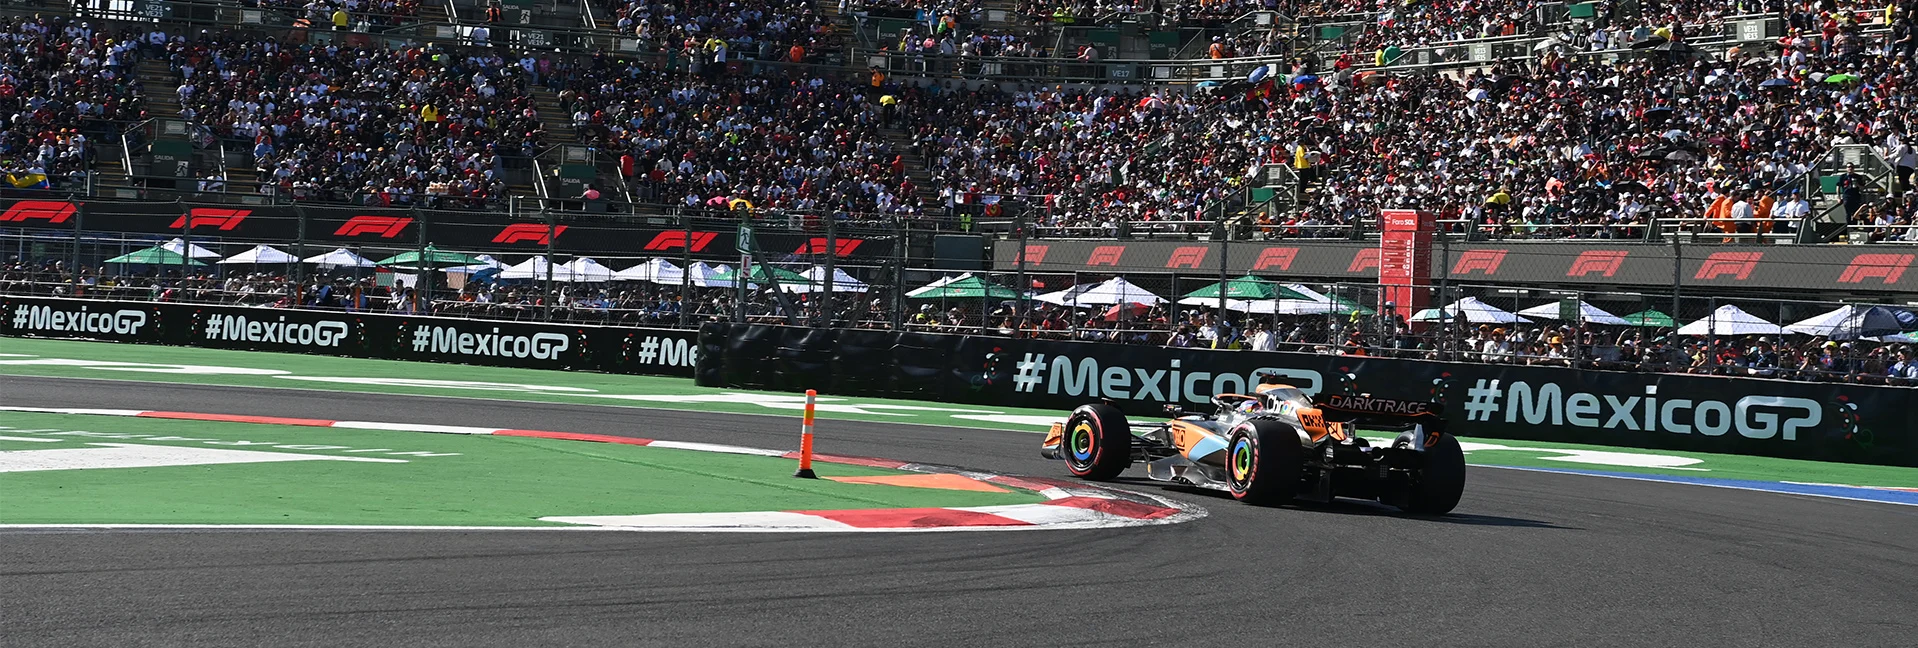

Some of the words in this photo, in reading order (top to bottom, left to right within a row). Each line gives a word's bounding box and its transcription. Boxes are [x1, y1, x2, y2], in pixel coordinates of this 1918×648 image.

[1347, 248, 1380, 272] F
[13, 304, 147, 335] #MexicoGP
[205, 313, 348, 347] #MexicoGP
[412, 324, 569, 360] #MexicoGP
[1329, 394, 1427, 414] DARKTRACE
[1464, 378, 1822, 442] #MexicoGP
